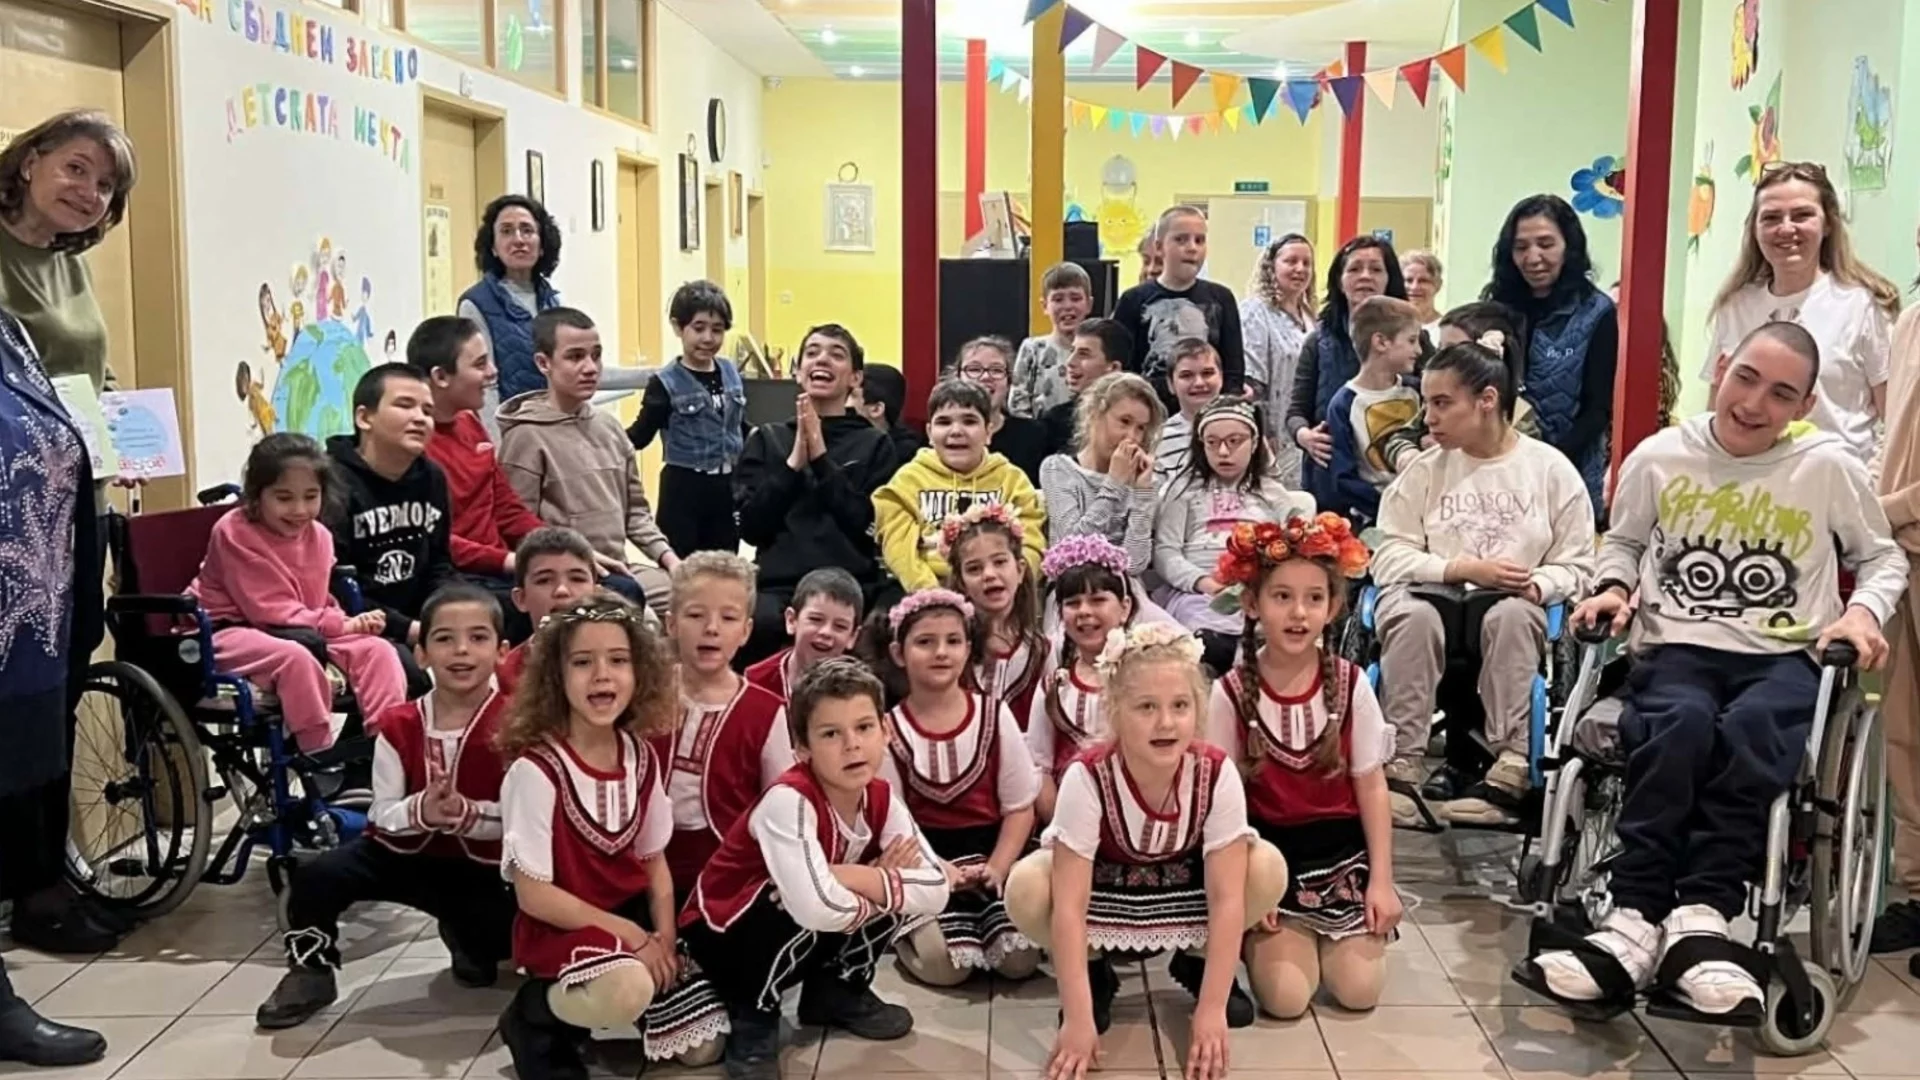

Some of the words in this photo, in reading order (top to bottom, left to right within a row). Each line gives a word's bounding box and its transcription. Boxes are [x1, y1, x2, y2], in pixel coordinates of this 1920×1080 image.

[346, 36, 418, 84] ЗАЕДНО
[226, 83, 340, 143] ДЕТСКАТА
[354, 105, 410, 174] МЕЧТА
[1440, 491, 1537, 521] BLOSSOM
